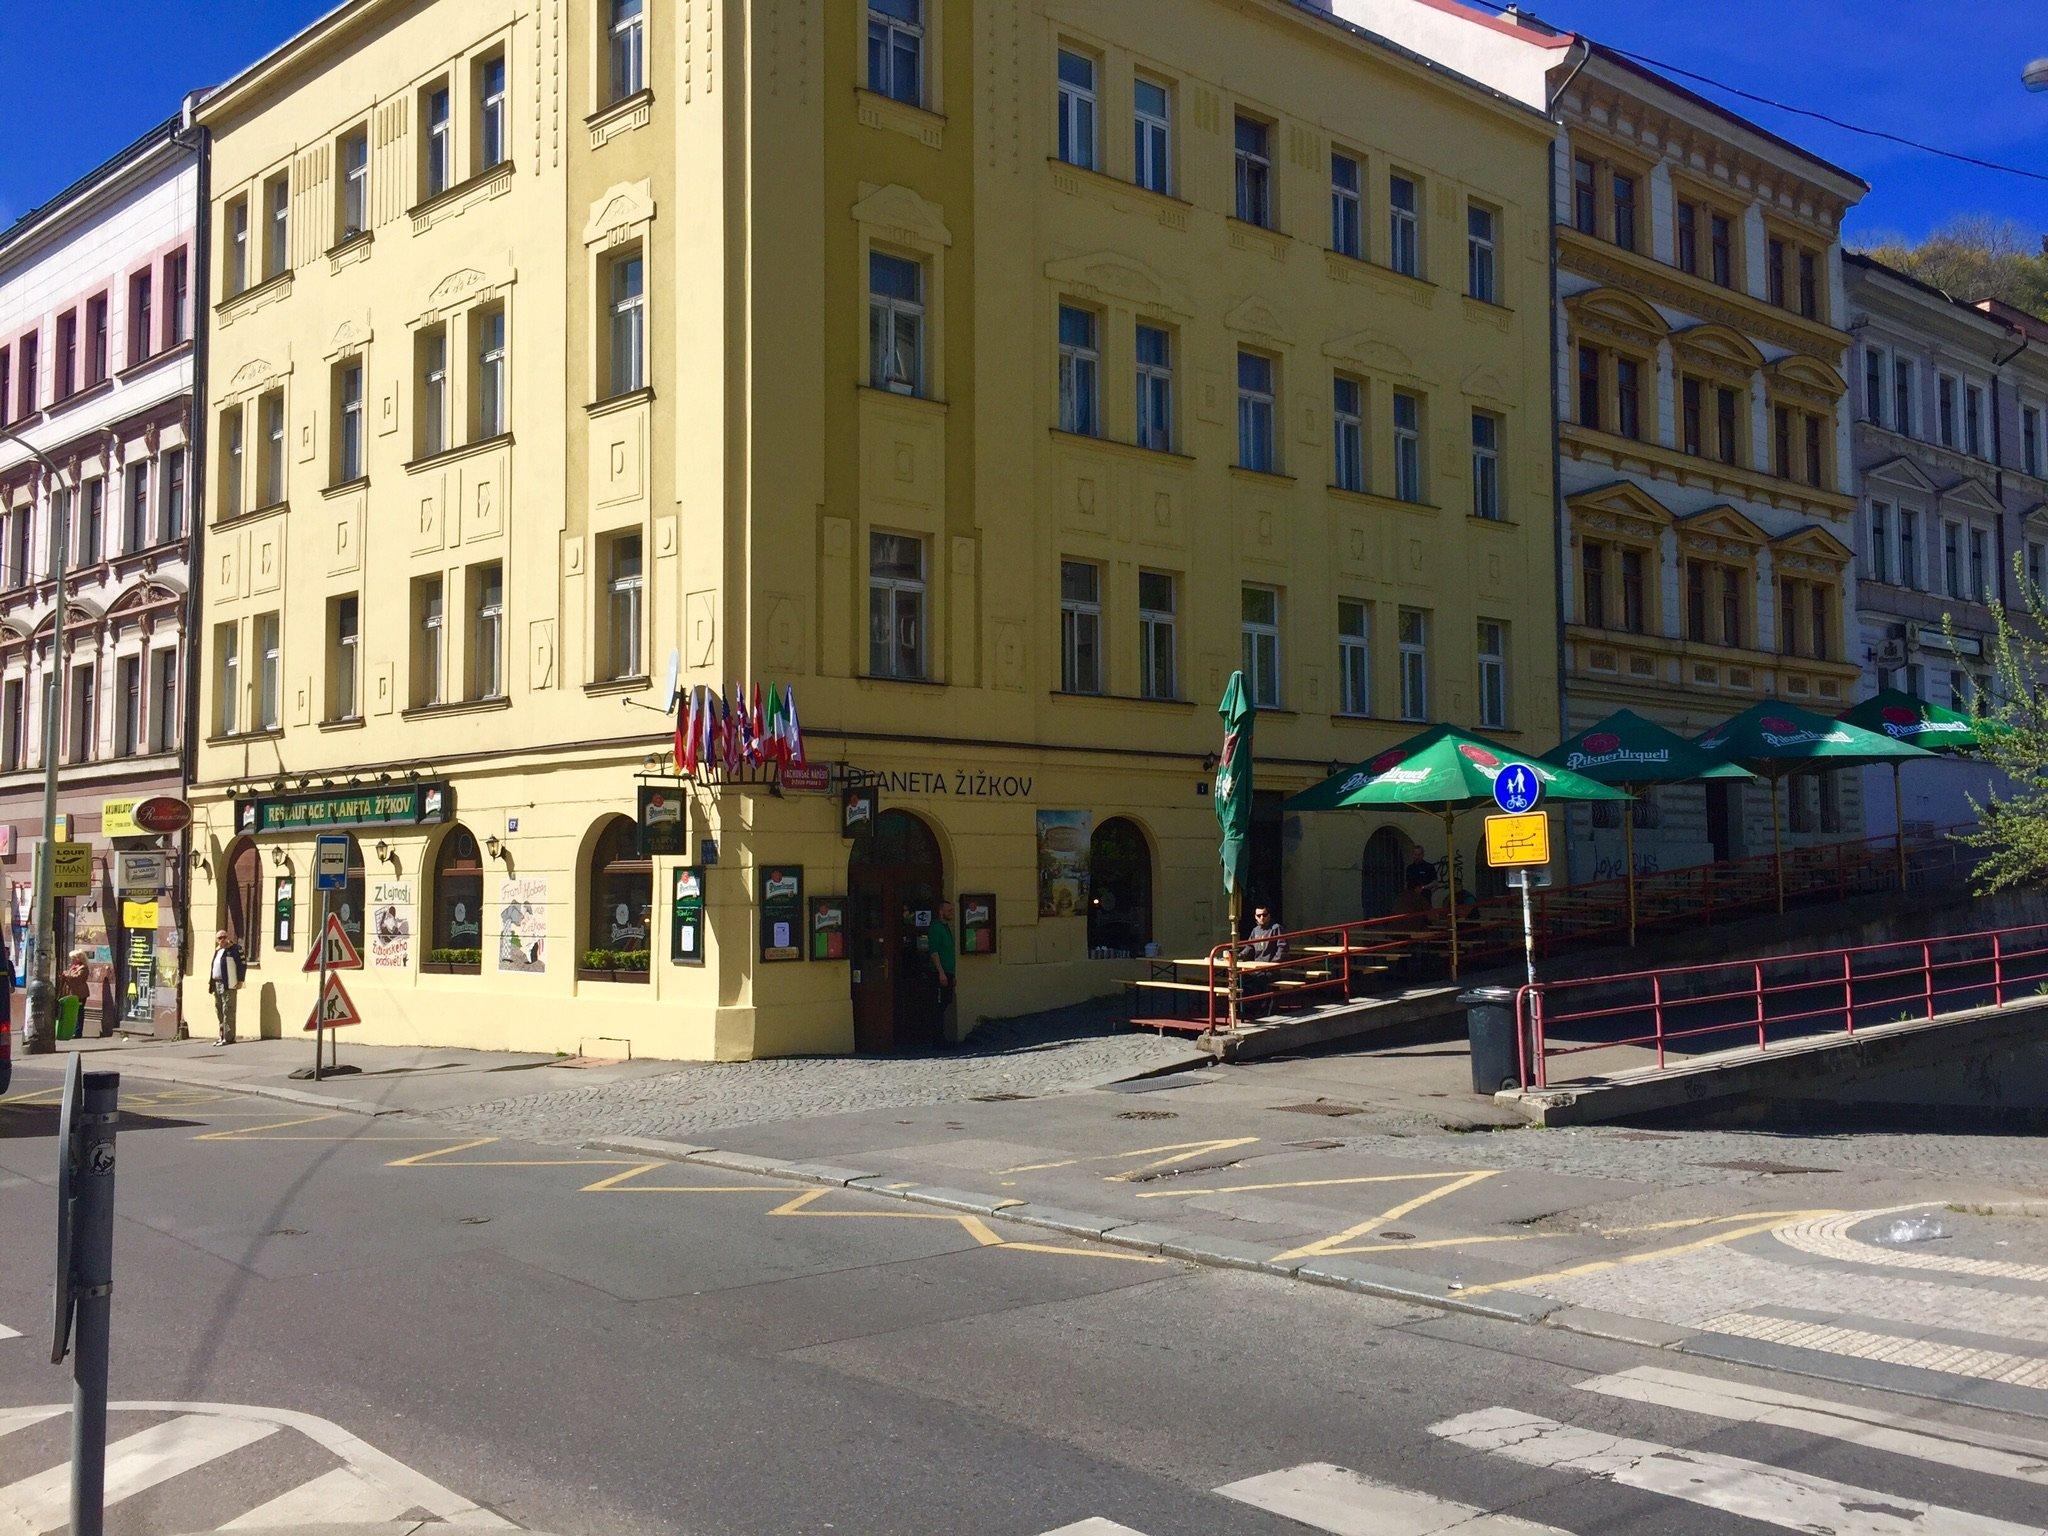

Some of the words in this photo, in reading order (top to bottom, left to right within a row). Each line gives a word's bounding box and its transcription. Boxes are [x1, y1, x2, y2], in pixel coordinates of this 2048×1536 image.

[1761, 732, 1805, 748] Pilsner
[1567, 752, 1619, 771] Pilsner
[1618, 748, 1669, 763] Urquell
[955, 769, 1033, 797] ŽIŽKOV
[269, 802, 325, 822] RESTAURACE
[328, 798, 371, 819] PLANETA
[375, 795, 411, 815] ŽIŽKOV
[374, 886, 382, 902] Z
